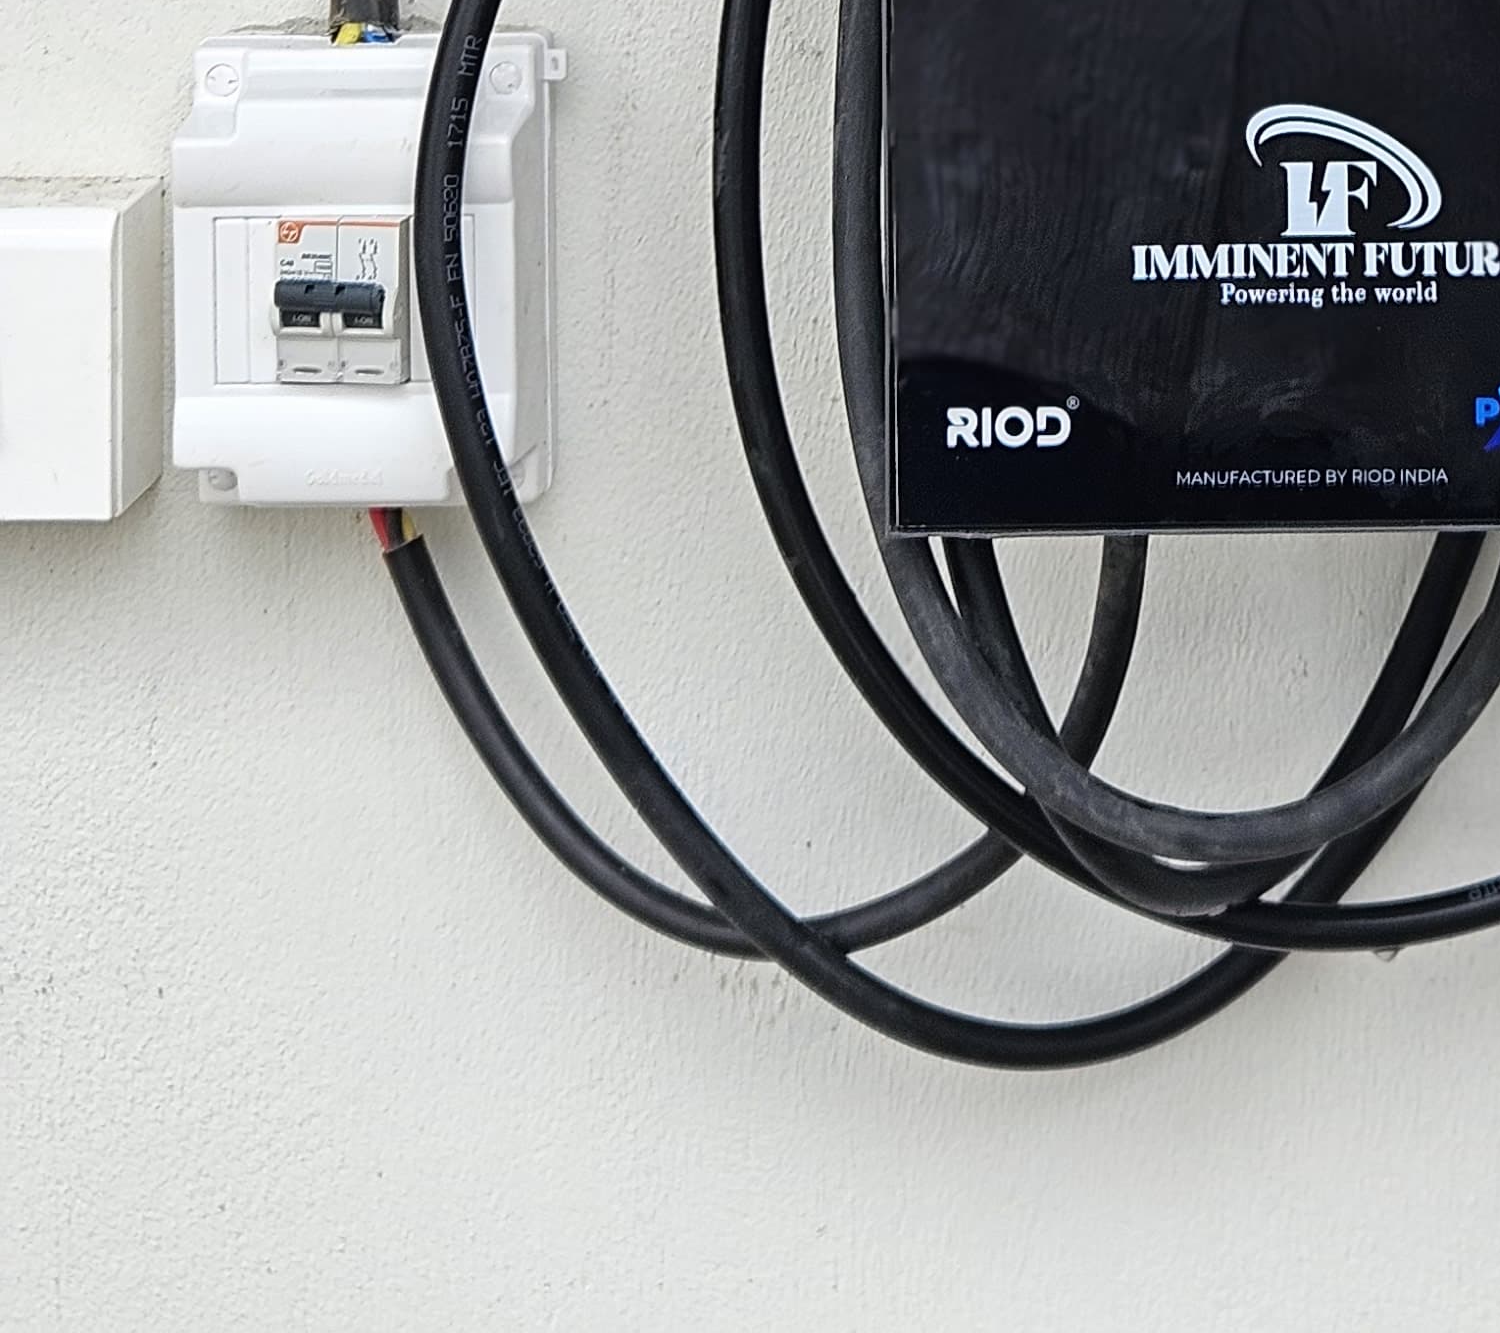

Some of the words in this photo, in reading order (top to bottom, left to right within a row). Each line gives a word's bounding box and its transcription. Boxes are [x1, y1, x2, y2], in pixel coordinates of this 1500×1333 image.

[456, 34, 483, 77] MTR
[447, 96, 469, 148] 1715
[442, 173, 460, 243] 50620
[1131, 242, 1355, 281] IMMINENT
[1220, 282, 1325, 310] Powering
[1331, 281, 1367, 304] the
[1374, 280, 1438, 304] world
[1176, 469, 1322, 487] MANUFACTURED
[1325, 469, 1348, 485] BY
[1352, 469, 1396, 485] RIOD
[1400, 468, 1449, 485] INDIA
